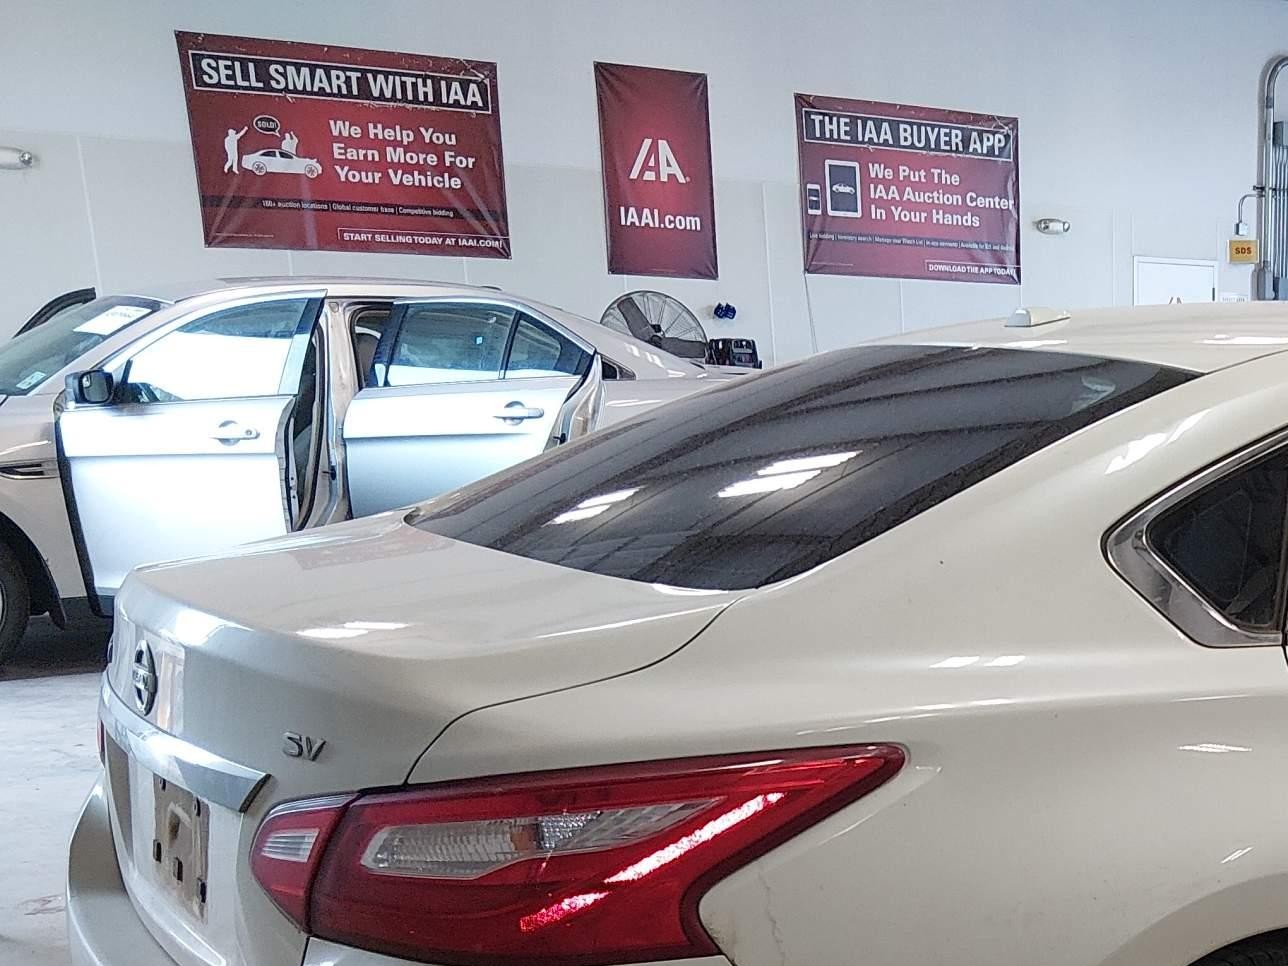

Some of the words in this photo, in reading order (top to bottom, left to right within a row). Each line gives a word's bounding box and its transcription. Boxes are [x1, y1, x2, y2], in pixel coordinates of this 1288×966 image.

[201, 58, 264, 88] SELL
[269, 64, 361, 96] SMART
[367, 73, 434, 102] WITH
[440, 80, 484, 107] IAA
[329, 120, 362, 138] We
[367, 122, 415, 145] Help
[419, 126, 457, 146] You
[811, 115, 851, 141] THE
[857, 119, 894, 145] IAA
[900, 123, 963, 152] BUYER
[969, 131, 1006, 156] APP
[332, 143, 380, 162] Earn
[386, 146, 438, 166] More
[444, 151, 476, 169] For
[334, 165, 382, 184] Your
[387, 168, 462, 190] Vehicle
[868, 163, 893, 179] We
[899, 166, 927, 183] Put
[931, 168, 960, 186] The
[869, 184, 900, 201] IAA
[903, 187, 962, 206] Auction
[966, 192, 1015, 210] Center
[620, 206, 701, 231] IAAI.com
[870, 205, 886, 220] In
[891, 206, 927, 223] Your
[932, 209, 980, 227] Hands
[343, 232, 372, 241] START
[374, 234, 412, 243] SELLING
[414, 236, 443, 245] TODAY
[445, 238, 457, 246] AT
[1235, 247, 1252, 255] SDS
[928, 264, 966, 273] DOWNLOAD
[282, 731, 327, 761] SV
